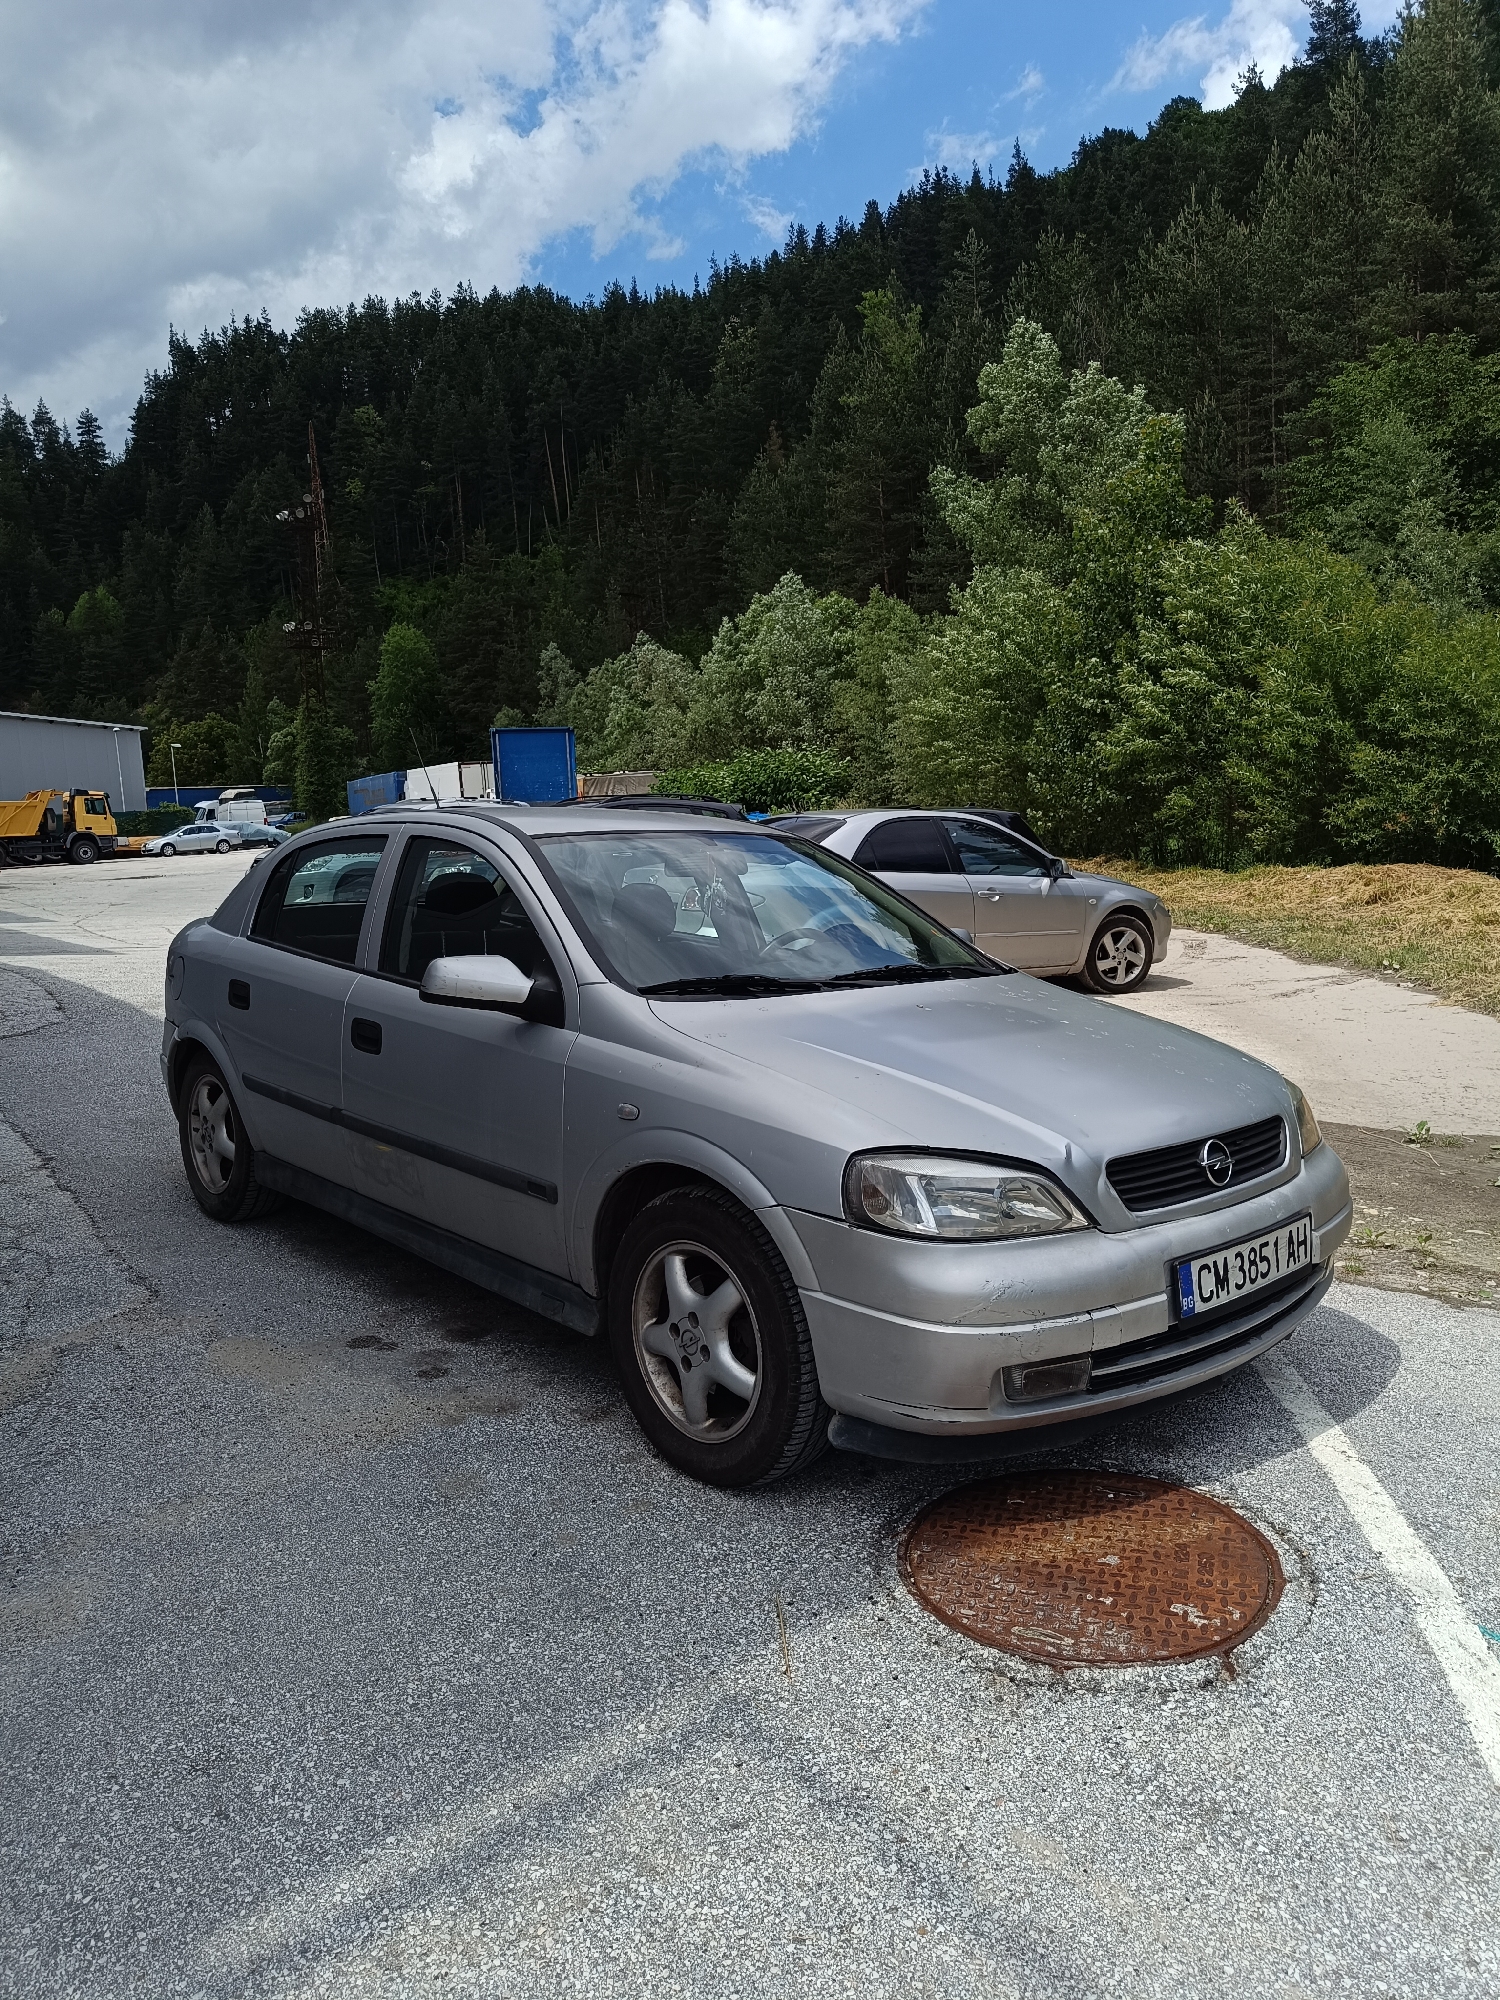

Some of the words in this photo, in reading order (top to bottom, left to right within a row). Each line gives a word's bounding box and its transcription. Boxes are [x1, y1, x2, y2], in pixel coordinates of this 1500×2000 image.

[1197, 1256, 1231, 1304] CM
[1233, 1236, 1280, 1291] 3851
[1286, 1223, 1308, 1269] AH
[1182, 1296, 1194, 1311] BG
[1197, 1552, 1216, 1577] 250
[1196, 1578, 1214, 1589] C
